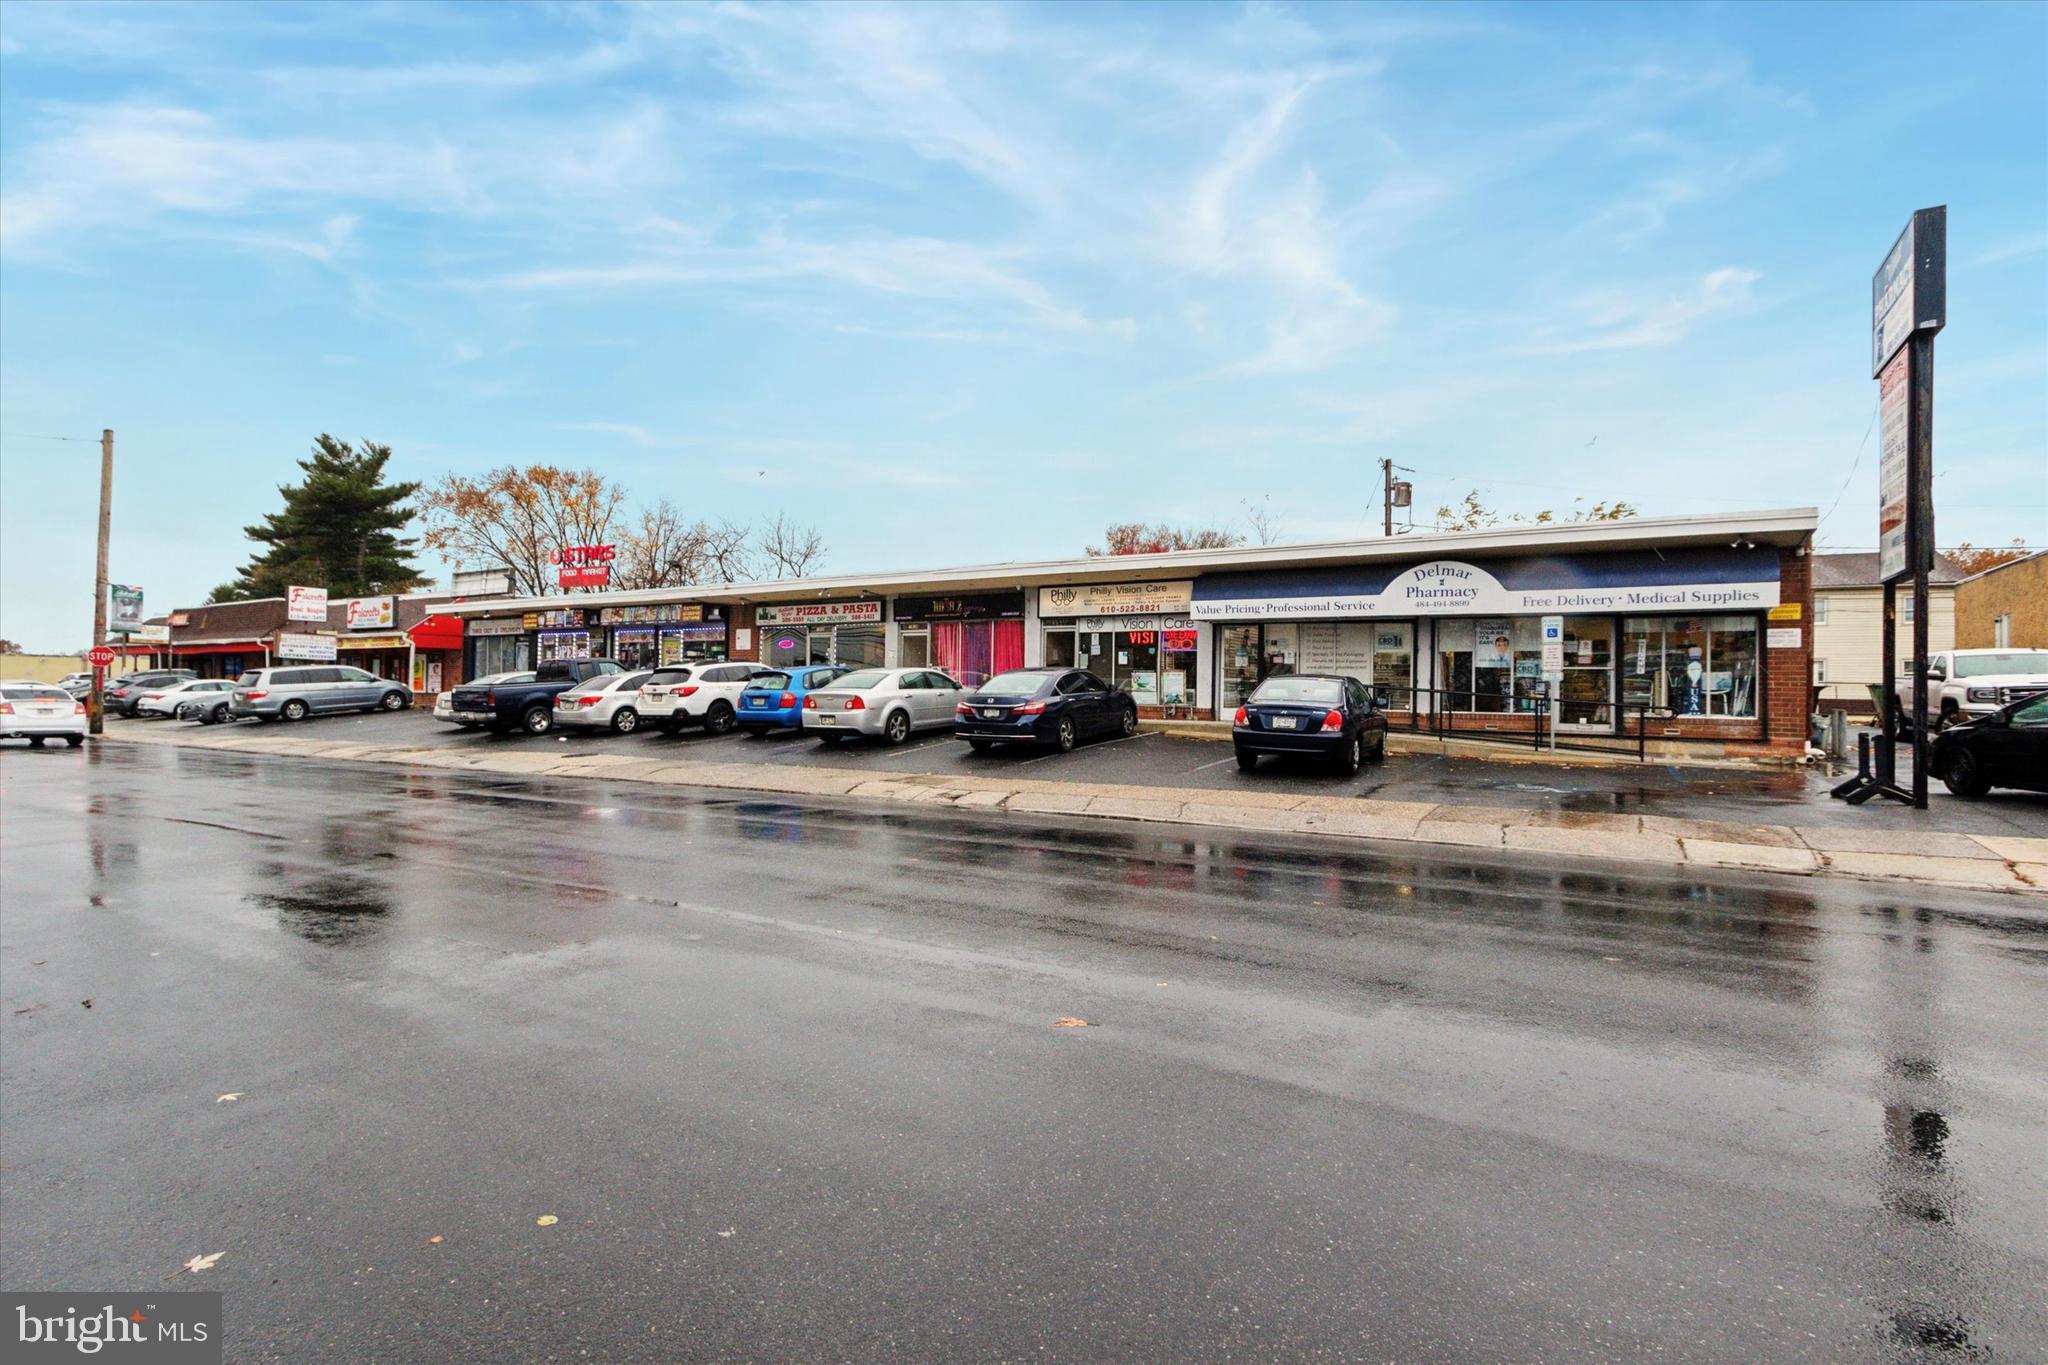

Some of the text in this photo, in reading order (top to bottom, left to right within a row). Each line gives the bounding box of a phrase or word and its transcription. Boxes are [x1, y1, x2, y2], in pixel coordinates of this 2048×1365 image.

[565, 545, 616, 563] STARS
[1414, 564, 1472, 582] Delmar
[1051, 588, 1077, 600] Philly
[1090, 586, 1112, 597] Philly
[1116, 585, 1142, 594] Vision
[1145, 584, 1167, 592] Care
[1406, 586, 1479, 600] Pharmacy
[1522, 590, 1760, 607] Free Delivery Medical Supplies
[801, 603, 883, 616] PIZZA & PASTA
[1100, 604, 1160, 613] 610-522-8821
[1196, 605, 1222, 615] Value
[1225, 604, 1261, 614] Pricing
[1266, 601, 1330, 612] Professional
[1333, 600, 1376, 611] Service
[1121, 618, 1153, 630] Vision
[1164, 617, 1194, 629] Care
[1130, 632, 1153, 644] VISI
[89, 652, 115, 661] STOP
[1517, 665, 1534, 674] CBD
